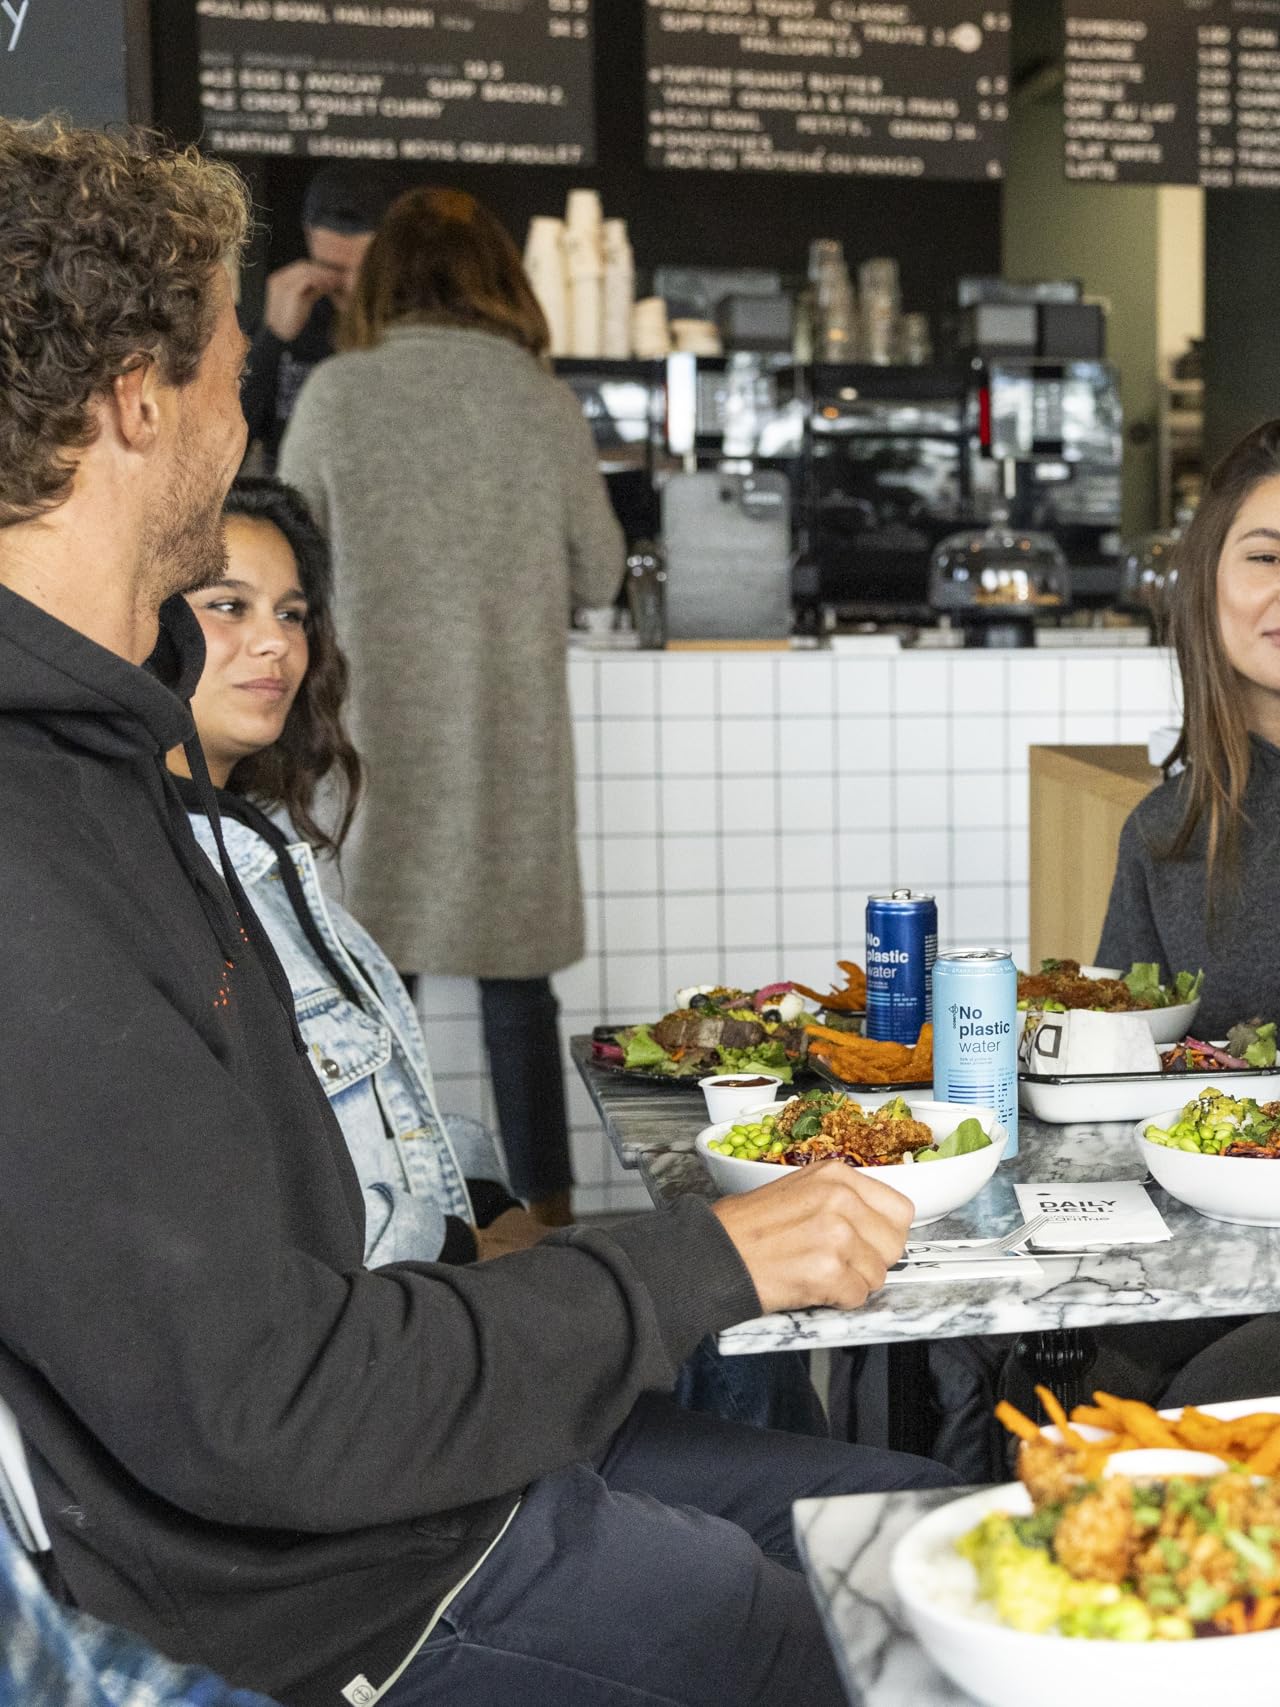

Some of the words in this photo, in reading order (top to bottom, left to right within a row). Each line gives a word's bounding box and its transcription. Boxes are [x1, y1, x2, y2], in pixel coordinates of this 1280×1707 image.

[273, 2, 331, 23] BOWL
[334, 6, 435, 28] HALLOUMI
[304, 72, 384, 94] AVOCAT
[867, 950, 909, 965] plastic
[960, 1006, 982, 1020] No
[960, 1021, 1010, 1039] plastic
[959, 1040, 1001, 1054] water
[1040, 1200, 1117, 1208] DAILY
